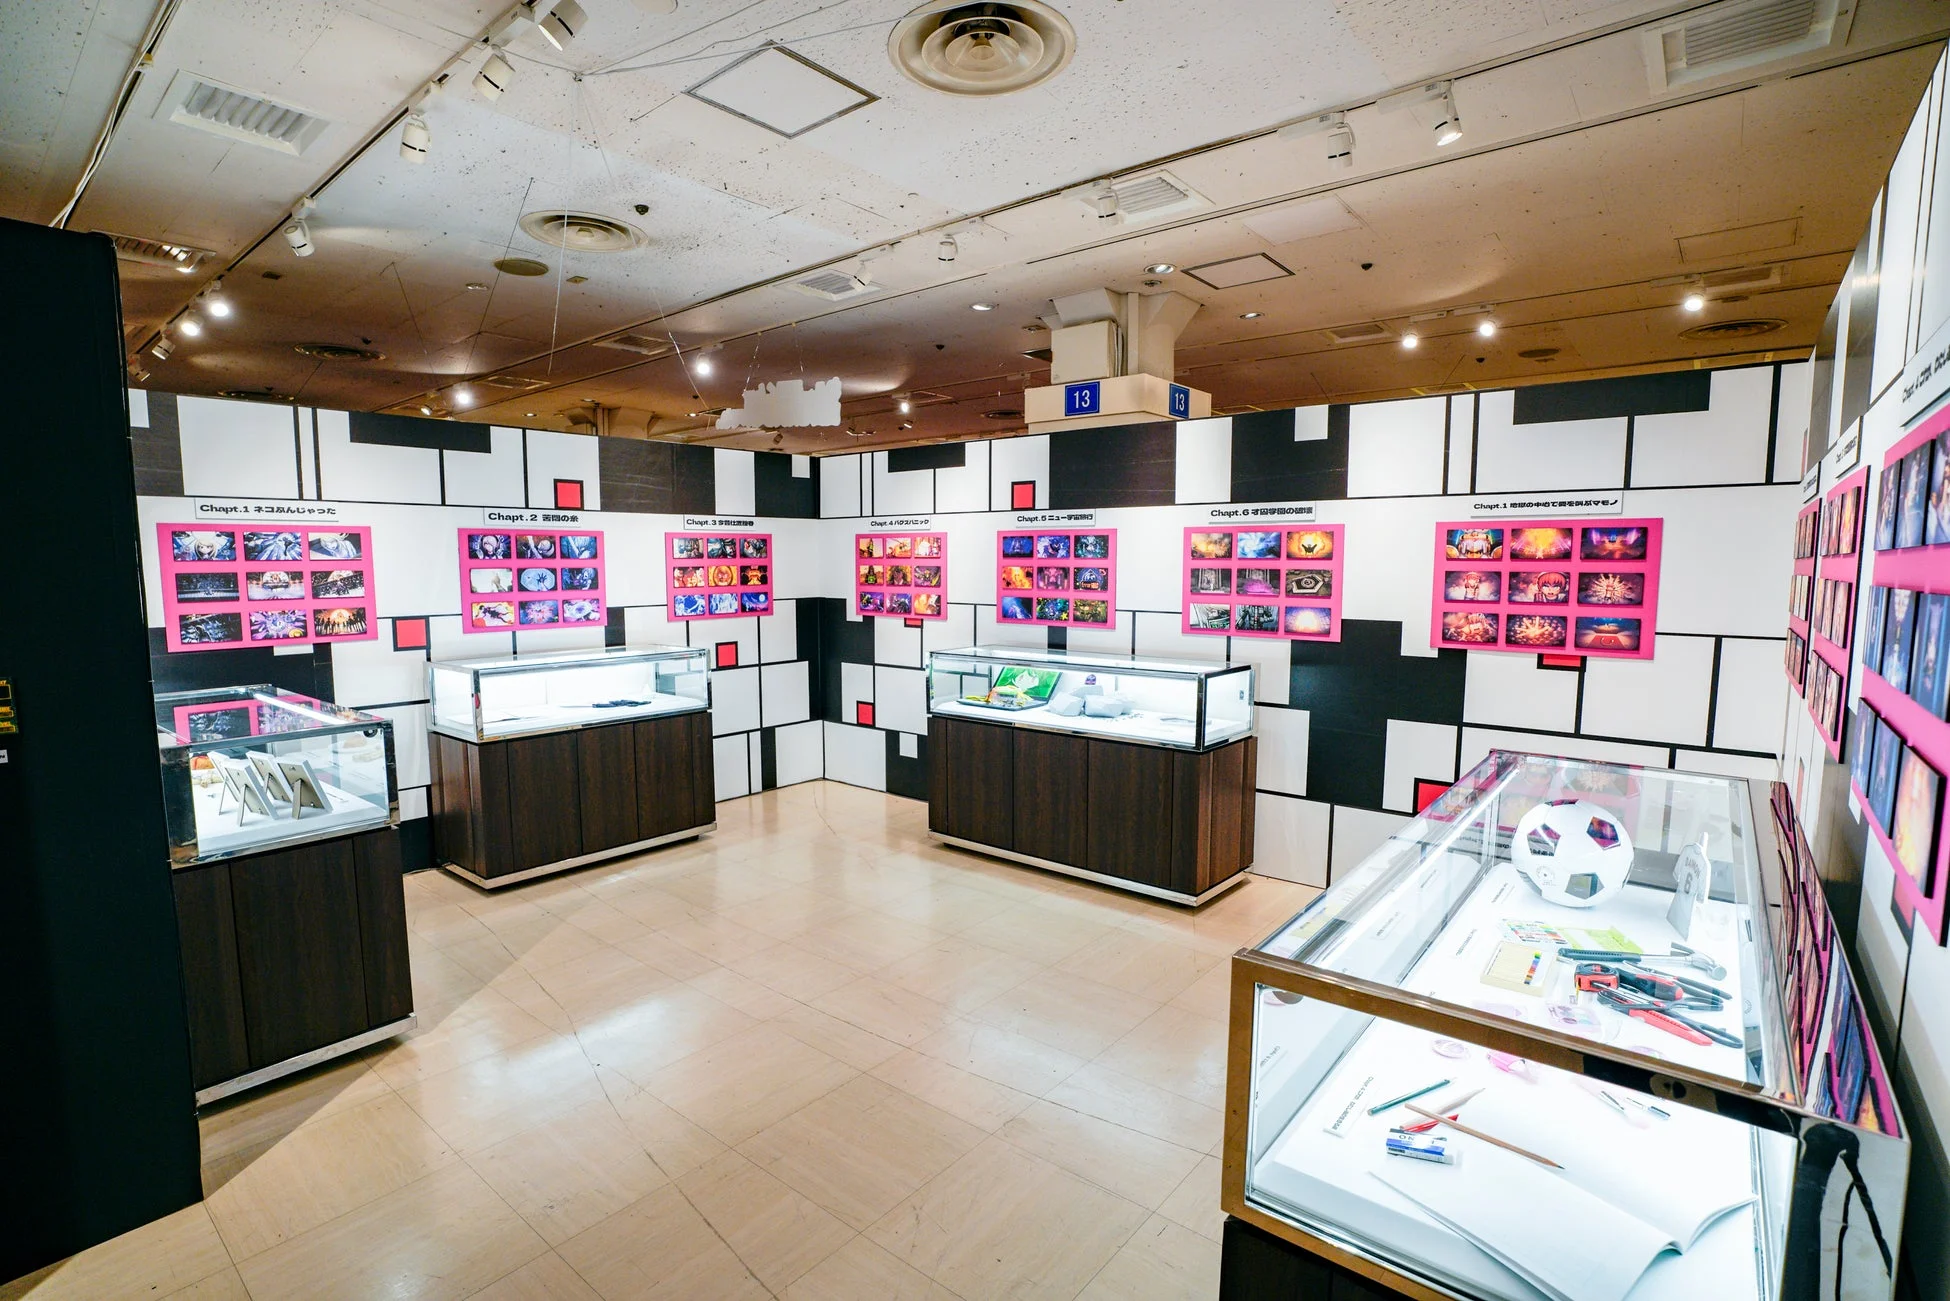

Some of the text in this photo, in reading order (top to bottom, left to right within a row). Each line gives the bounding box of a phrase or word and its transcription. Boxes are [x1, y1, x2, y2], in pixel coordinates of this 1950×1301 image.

[1073, 389, 1091, 409] 13
[1174, 393, 1185, 411] 13
[200, 504, 249, 514] Chapt.1
[1473, 502, 1507, 510] Chapt.1
[488, 512, 538, 523] Chapt.2
[1210, 509, 1249, 518] Chapt.6
[686, 518, 717, 527] Chapt.3
[1017, 515, 1047, 523] Chapt.5
[1684, 872, 1693, 894] 6
